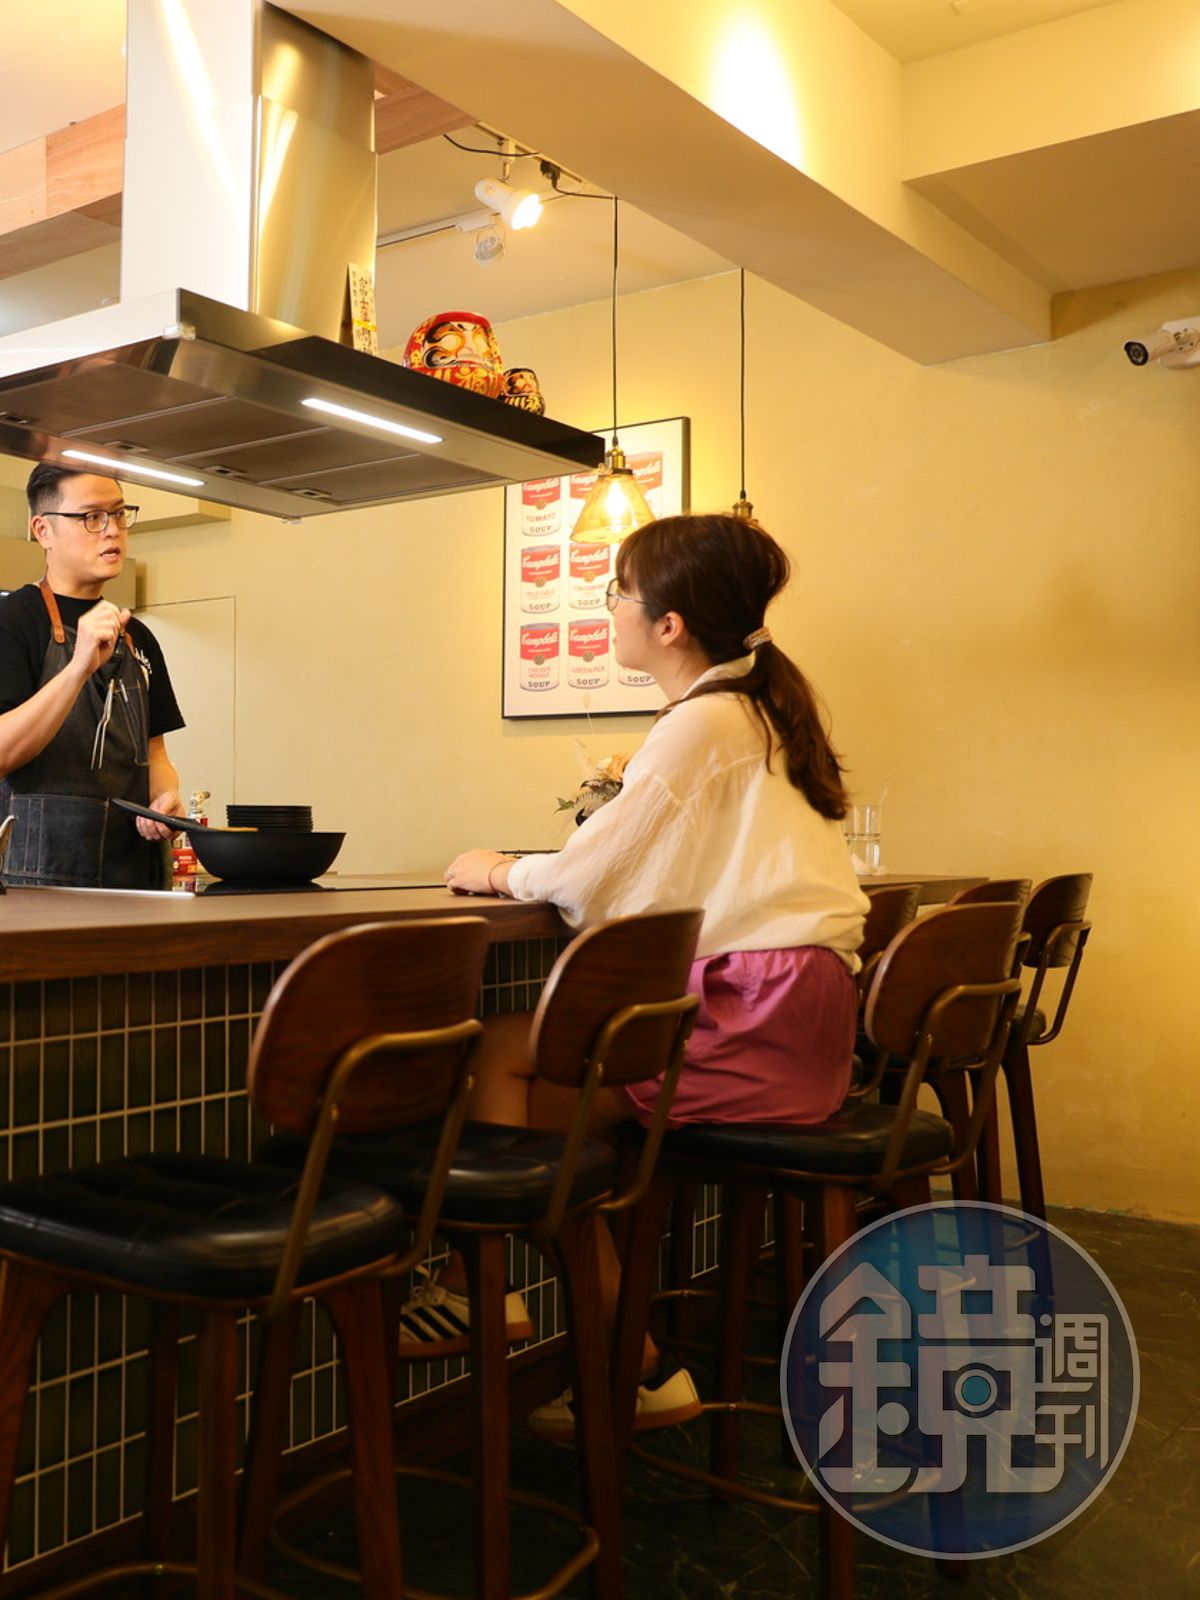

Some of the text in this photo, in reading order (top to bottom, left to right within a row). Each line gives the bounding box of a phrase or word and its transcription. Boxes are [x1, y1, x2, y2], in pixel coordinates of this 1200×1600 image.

[526, 512, 557, 522] TOMATO
[529, 524, 553, 533] SOUP
[529, 603, 552, 611] SOUP
[577, 599, 601, 607] SOUP
[576, 678, 601, 686] SOUP
[627, 675, 652, 683] SOUP
[528, 680, 551, 689] SOUP
